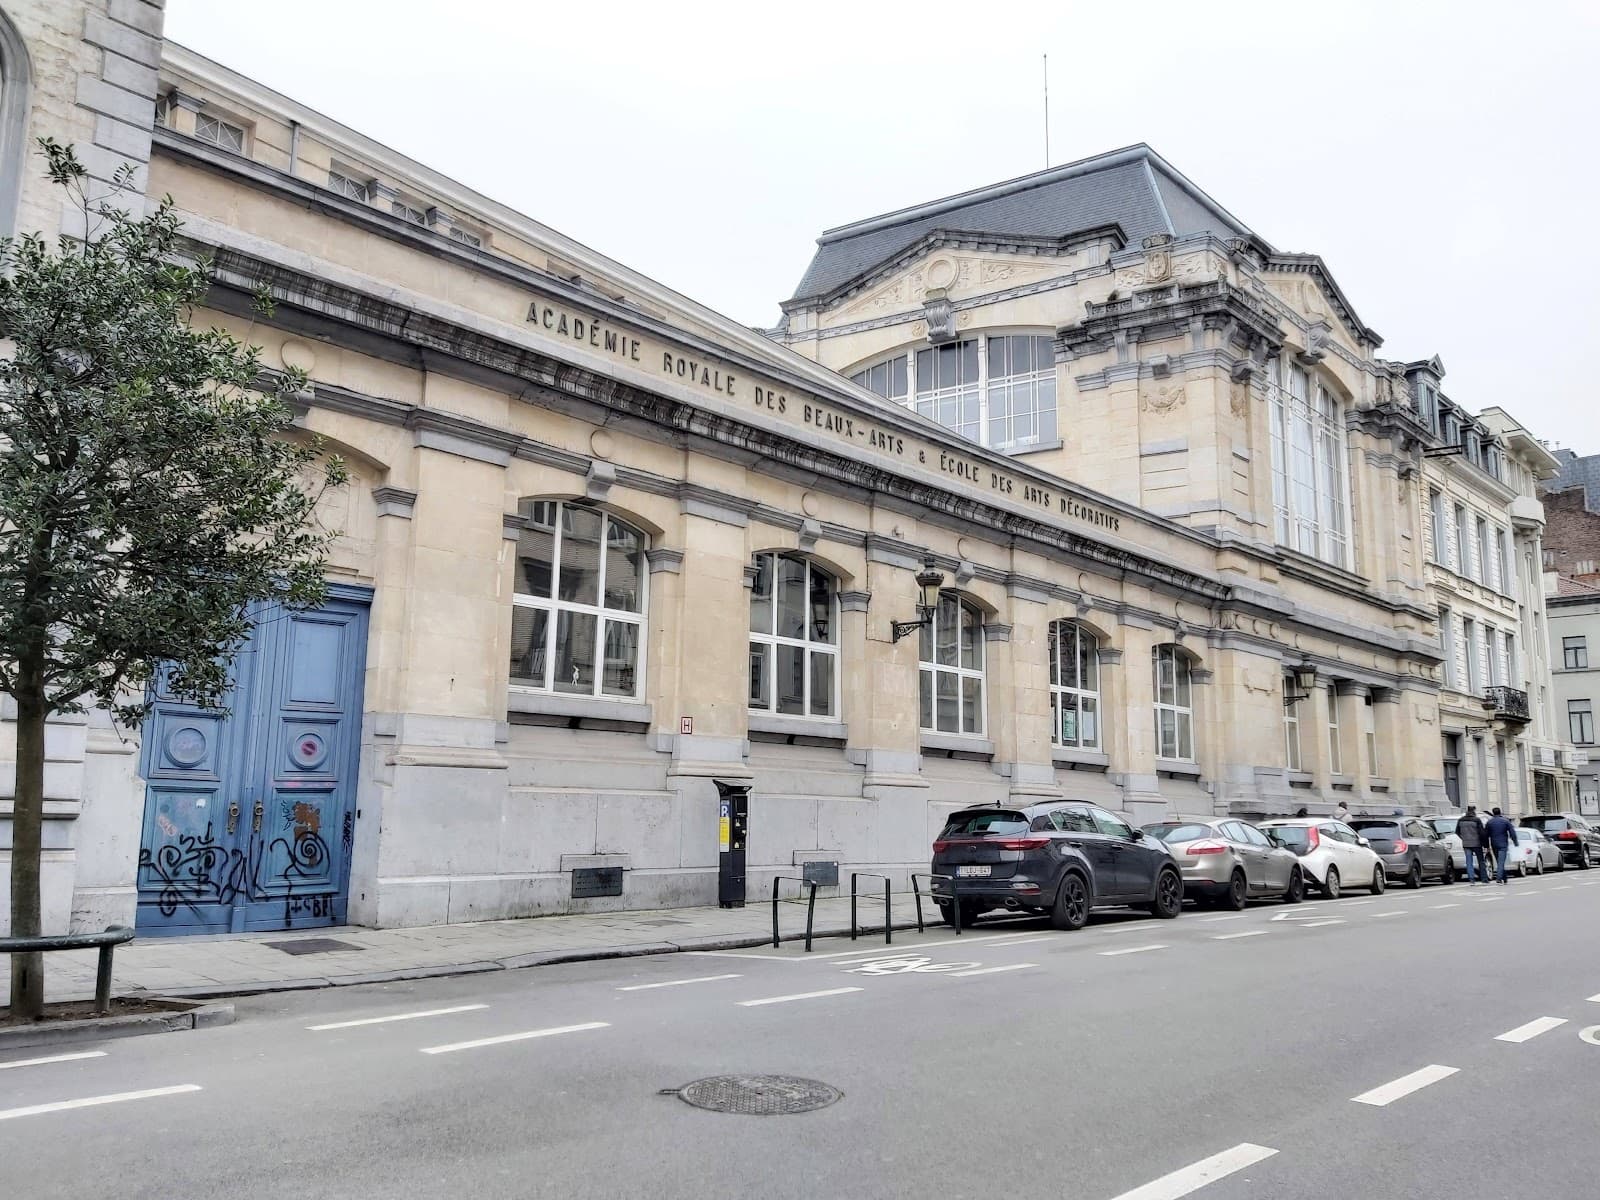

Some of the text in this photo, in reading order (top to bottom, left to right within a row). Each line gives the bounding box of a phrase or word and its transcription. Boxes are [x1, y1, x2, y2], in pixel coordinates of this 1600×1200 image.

[526, 302, 1119, 531] ACADÉMIE ROYALE DES BEAUX-ARTS & ÉCOLE DES ARTS DÉCORATIFS
[683, 719, 691, 732] H
